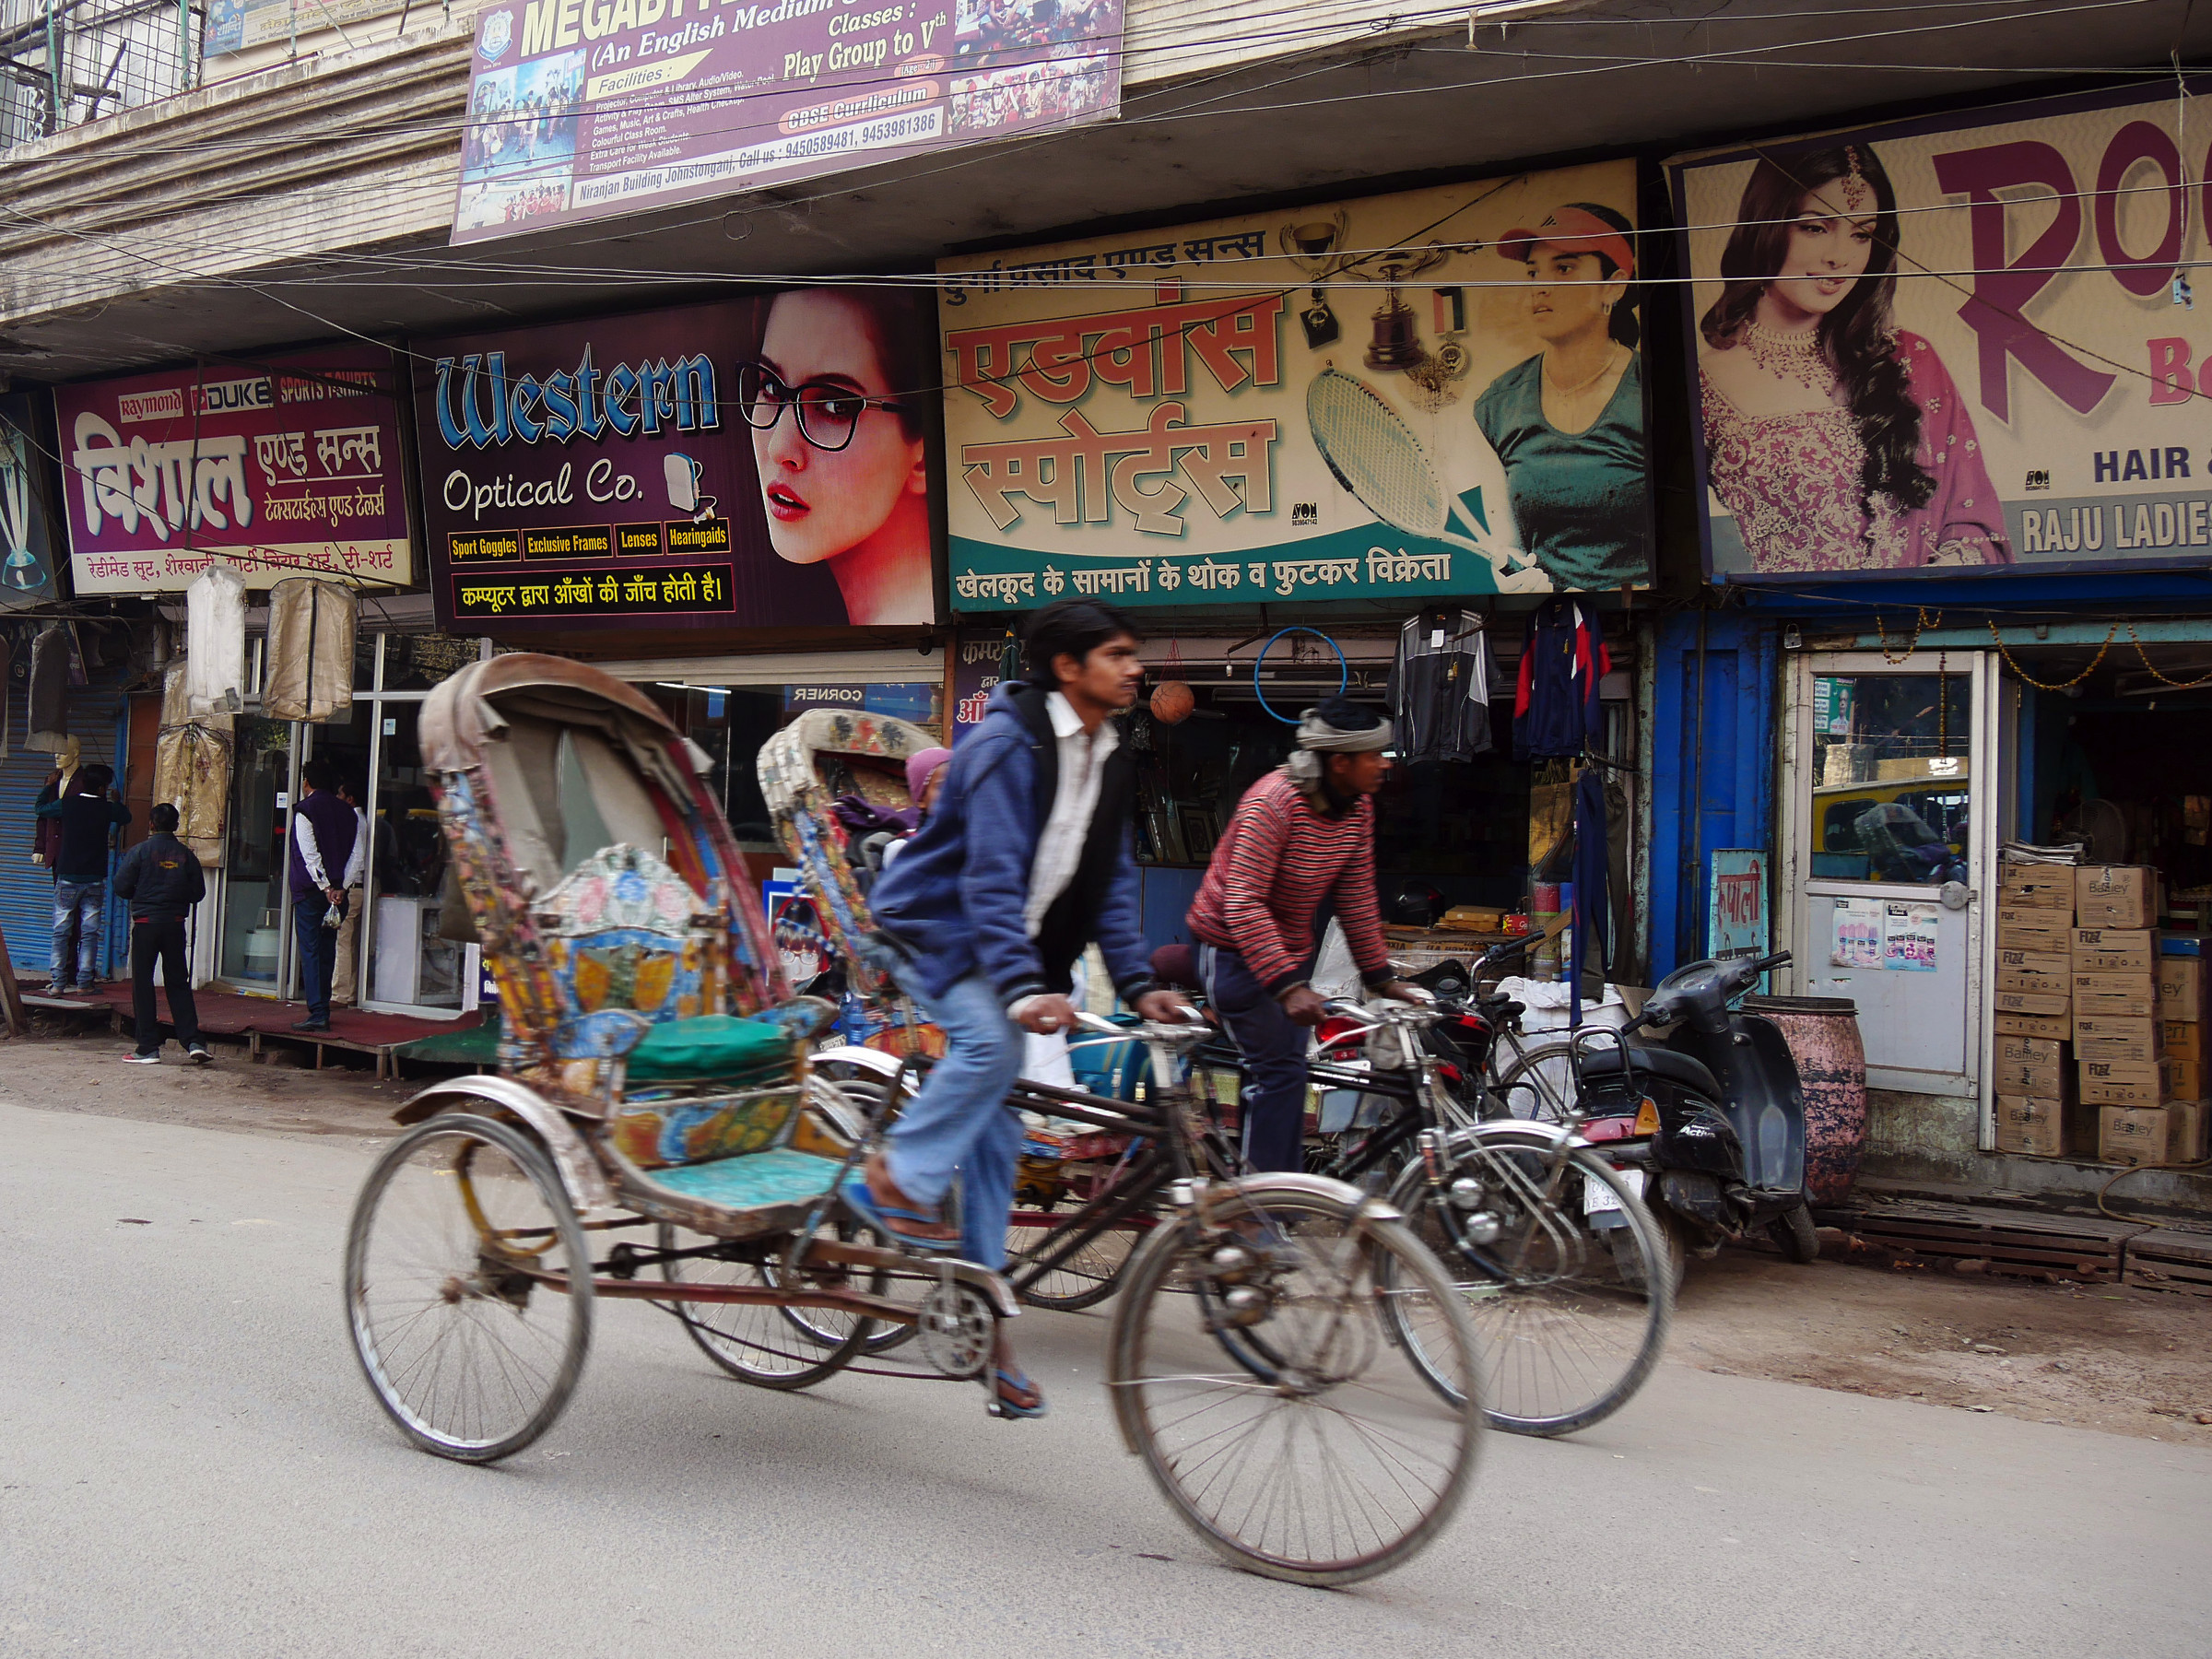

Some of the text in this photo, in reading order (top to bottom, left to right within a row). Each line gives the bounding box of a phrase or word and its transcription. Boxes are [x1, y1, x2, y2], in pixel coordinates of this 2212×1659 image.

[592, 0, 832, 72] (An English Medium
[829, 6, 903, 37] Classes
[782, 51, 823, 83] Play
[829, 38, 888, 69] Group
[893, 29, 913, 56] to
[598, 69, 663, 94] Facilities
[668, 96, 685, 106] SMS
[642, 114, 654, 125] Art
[687, 102, 710, 115] Health
[788, 104, 830, 129] CBSE
[580, 181, 620, 201] Niranjan
[623, 171, 663, 192] Building
[740, 149, 760, 168] Call
[763, 150, 775, 163] us
[862, 112, 935, 144] 9453981386
[589, 158, 622, 172] Transport
[622, 150, 647, 165] Facility
[590, 151, 608, 161] Extra
[609, 147, 625, 157] Care
[626, 143, 636, 153] for
[592, 133, 623, 148] Colourful
[624, 129, 643, 142] Class
[942, 230, 1266, 306] दुर्गा प्रसाद एण्ड सन्स
[1932, 121, 2212, 425] RO
[946, 276, 1287, 420] एडवांस
[2147, 337, 2212, 406] B
[207, 380, 273, 409] DUKE
[279, 375, 324, 404] SPORTS
[436, 342, 720, 451] Western
[73, 411, 252, 543] विशाल
[253, 425, 382, 487] एण्ड सन्स
[962, 401, 1279, 536] स्पोर्ट्स
[2093, 447, 2192, 483] HAIR
[327, 495, 354, 528] एण्ड
[355, 484, 385, 516] टेलर्स
[443, 458, 643, 522] Optical Co.
[452, 526, 727, 559] Sport Goggles Exclusive Frames Lenses Hearingaids
[2021, 500, 2212, 554] RAJU LADIE
[86, 556, 130, 578] रेडीमेड
[166, 553, 215, 576] शेरवानी
[341, 544, 394, 571] टी-शर्ट
[955, 546, 1453, 605] खेलकूद के सामानों के थोक व फुटकर विक्रेता
[461, 584, 516, 613] कम्प्यूटर
[519, 584, 549, 607] द्वारा
[554, 576, 594, 605] आँखों
[597, 575, 619, 604] की
[623, 573, 657, 603] जाँच
[662, 573, 697, 602] होती
